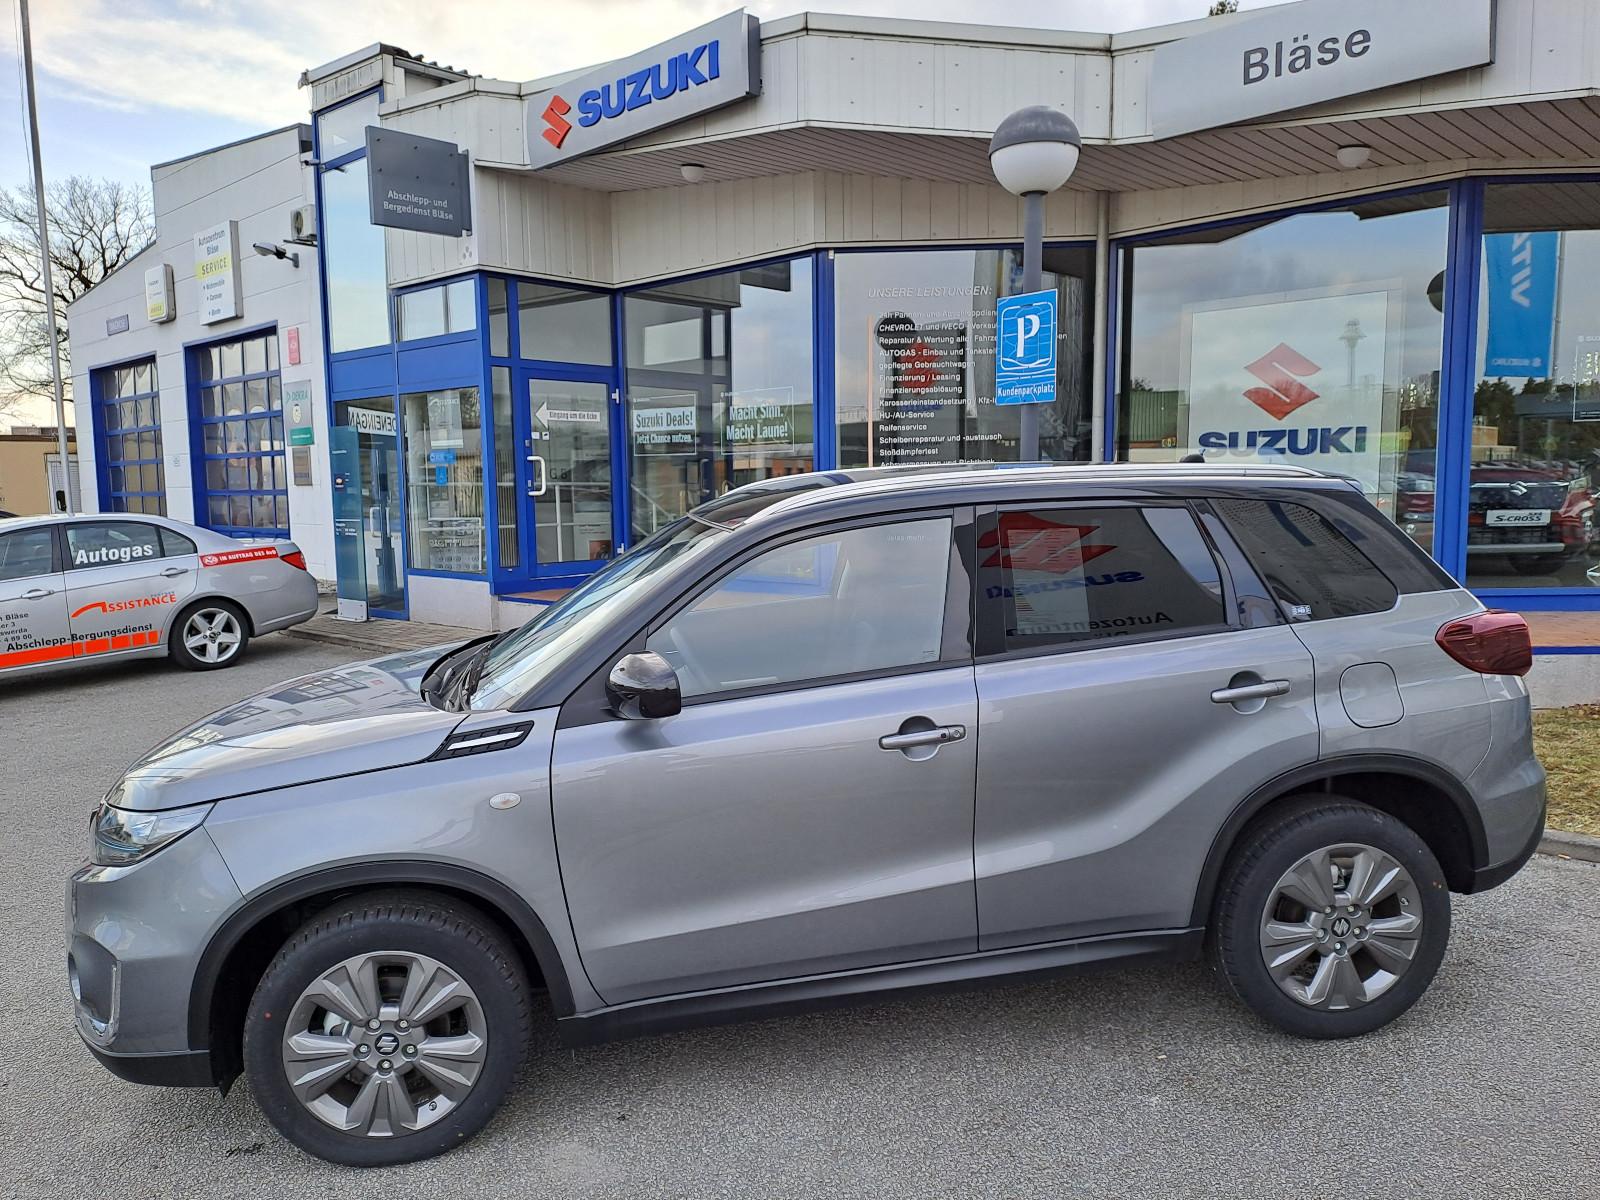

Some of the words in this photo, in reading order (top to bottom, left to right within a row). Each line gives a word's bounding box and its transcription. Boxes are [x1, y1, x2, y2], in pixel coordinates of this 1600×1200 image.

[1243, 29, 1371, 85] Bläse
[577, 39, 719, 128] SUZUKI
[388, 190, 431, 204] Abschlepp-
[433, 199, 448, 208] und
[383, 201, 430, 216] Bergedienst
[432, 209, 453, 220] Bläse
[201, 257, 227, 275] SERVICE
[868, 287, 914, 298] UNSERE
[917, 285, 992, 297] LEISTUNGEN:
[879, 323, 923, 332] CHEVROLET
[941, 322, 965, 330] IVECO
[879, 336, 914, 345] Reparatur
[924, 335, 954, 344] Wartung
[879, 349, 916, 357] AUTOGAS
[923, 348, 948, 356] Einbau
[879, 361, 913, 371] gepflegte
[914, 360, 976, 370] Gebrauchtwagen
[879, 373, 926, 383] Finanzierung
[931, 372, 961, 382] Leasing
[879, 385, 963, 395] Finanzierungsablösung
[997, 383, 1055, 397] Kundenparkplatz
[729, 405, 758, 421] Macht
[760, 403, 784, 418] Sinn.
[879, 411, 935, 419] HU-/AU-Service
[635, 411, 664, 429] Suzuki
[666, 410, 693, 426] Deals!
[726, 423, 755, 441] Macht
[757, 421, 788, 439] Laune!
[879, 423, 928, 432] Reifenservice
[636, 433, 650, 444] Jetzt
[650, 433, 671, 444] Chance
[672, 432, 693, 443] nutzen.
[879, 435, 945, 444] Scheibenreparatur
[947, 434, 961, 442] und
[963, 432, 1002, 441] -austausch
[1197, 426, 1368, 458] SUZUKI
[879, 447, 939, 457] Stoßdämpfertest
[75, 544, 154, 565] Autogas
[228, 552, 254, 561] AUFTRAG
[5, 612, 29, 621] Bläse
[7, 623, 153, 652] Abschlepp-Bergungsdienst
